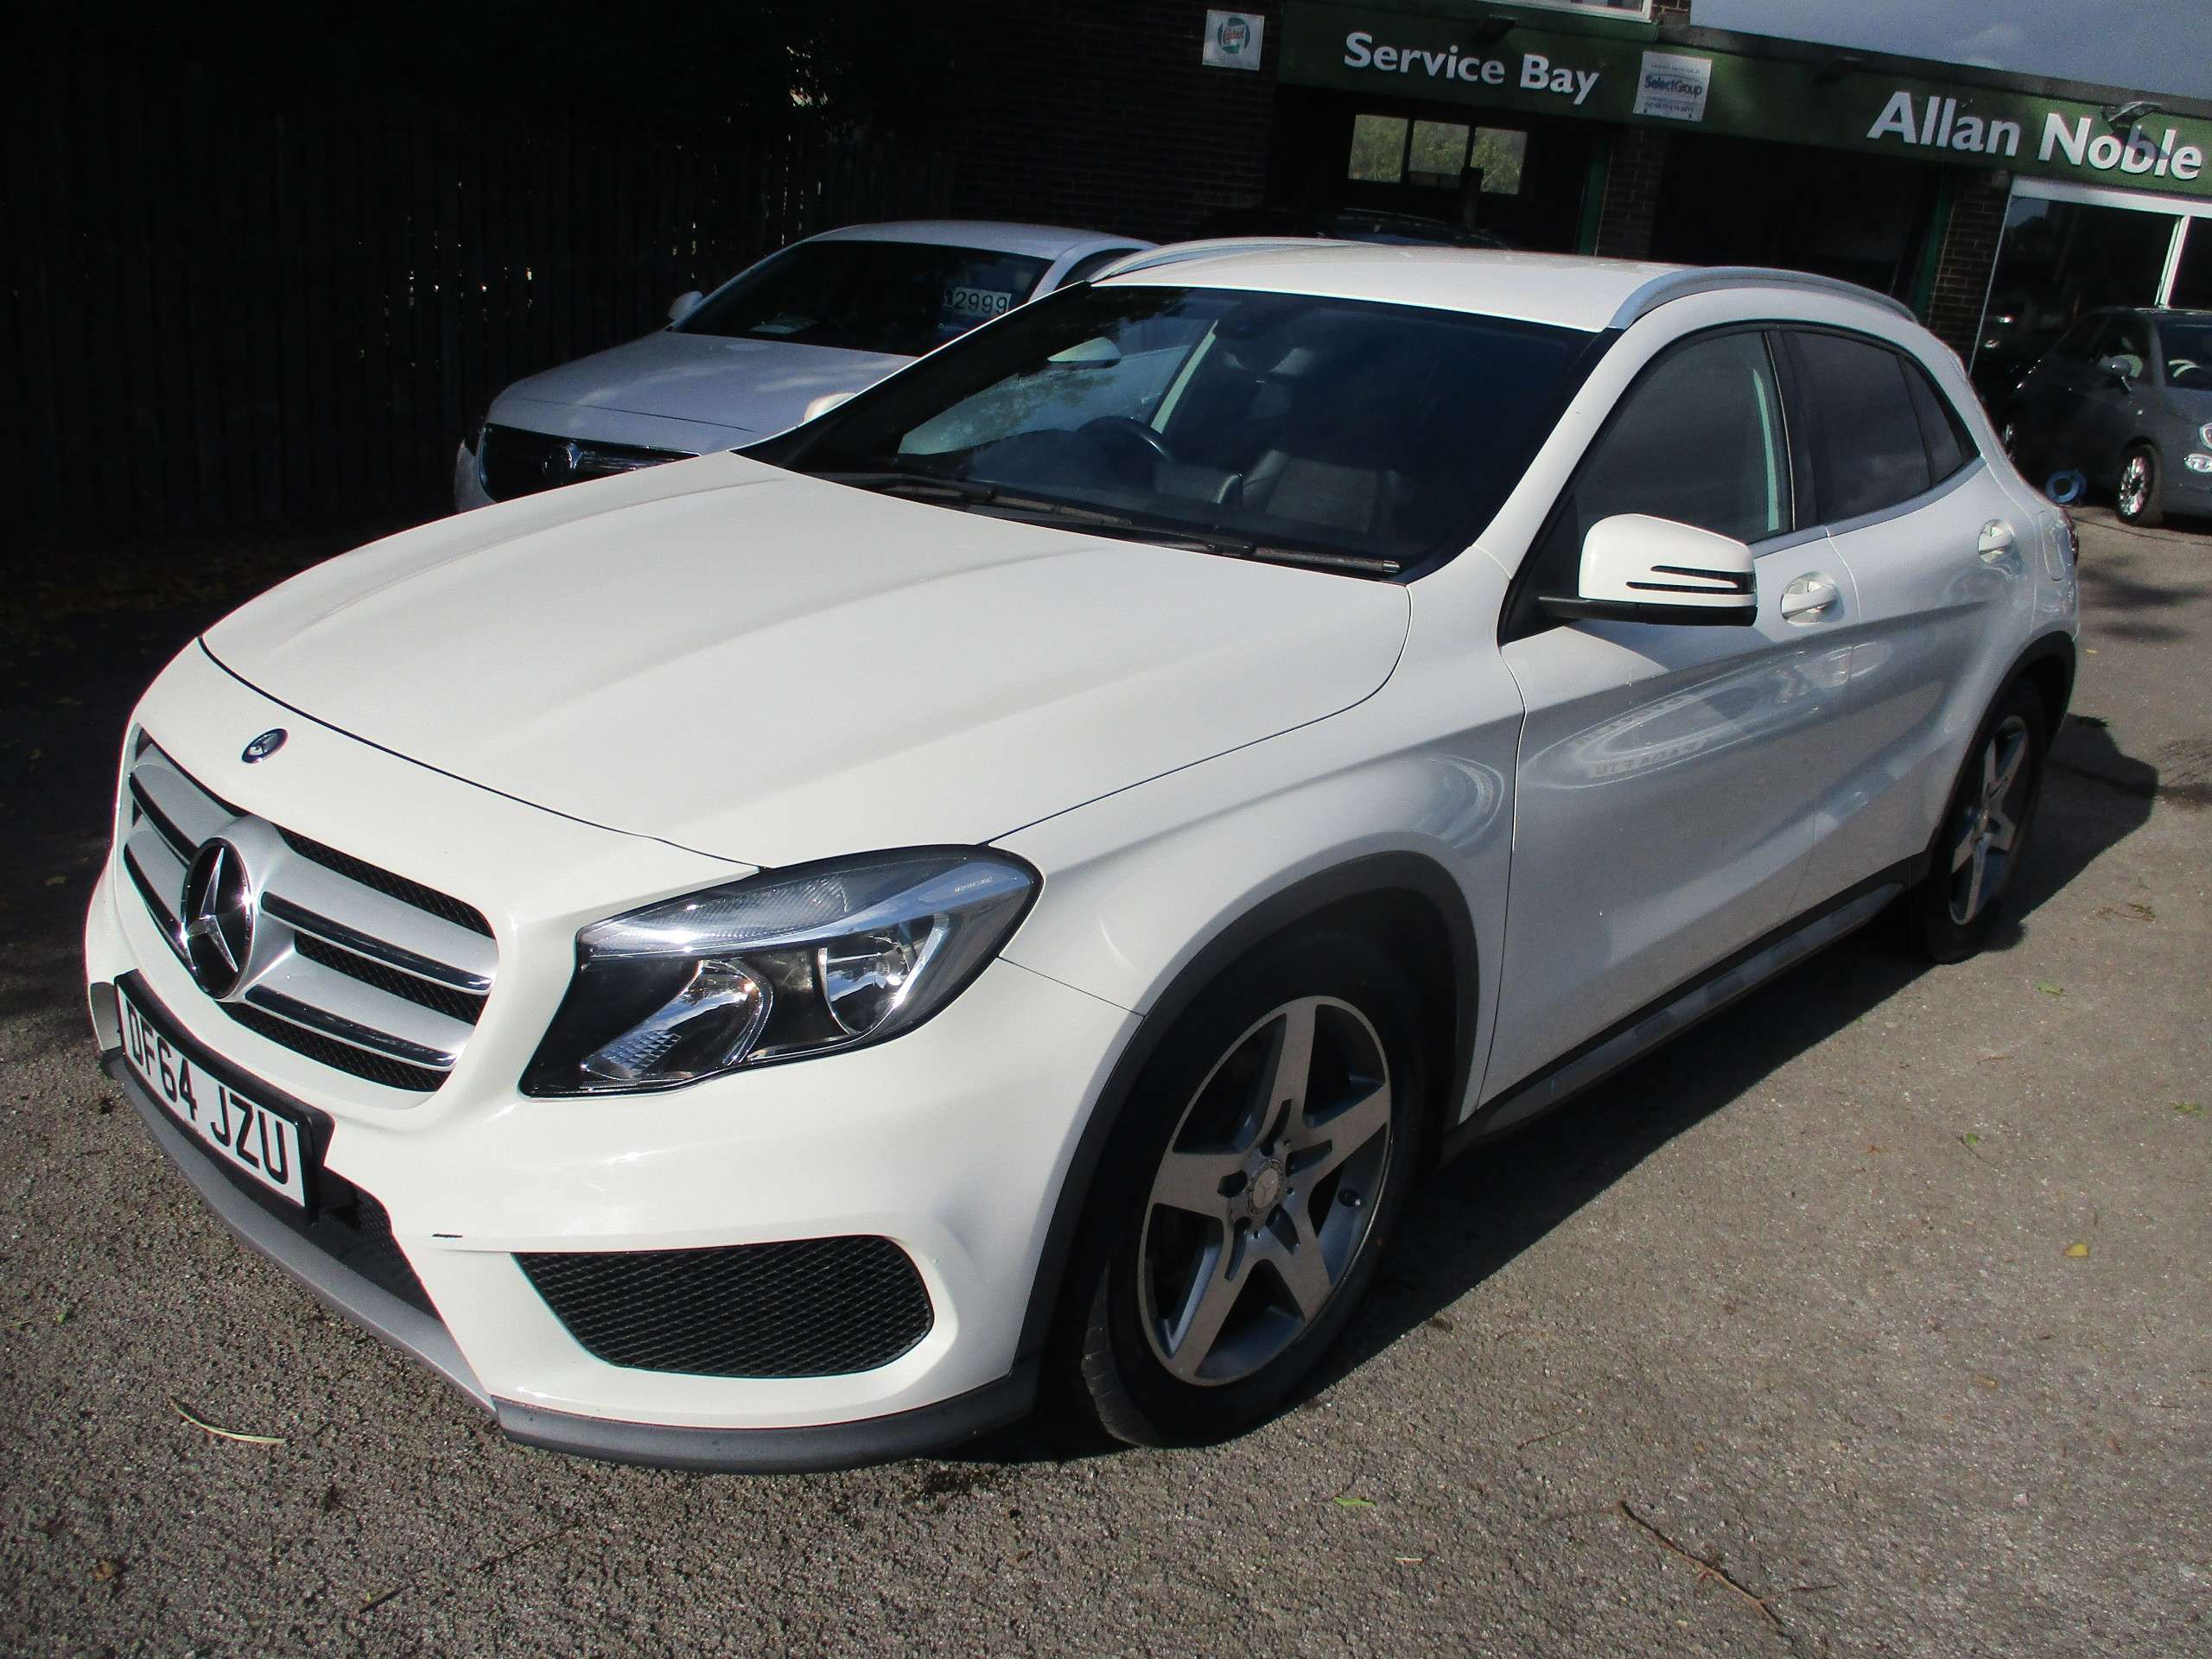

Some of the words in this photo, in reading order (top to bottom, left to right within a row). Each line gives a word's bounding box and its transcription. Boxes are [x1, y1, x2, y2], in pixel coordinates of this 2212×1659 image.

[1344, 32, 1505, 85] Service
[1519, 53, 1599, 105] Bay
[1866, 90, 2021, 157] Allan
[2037, 111, 2203, 180] Noble
[127, 1002, 199, 1122] DF64
[210, 1085, 289, 1185] JZU
